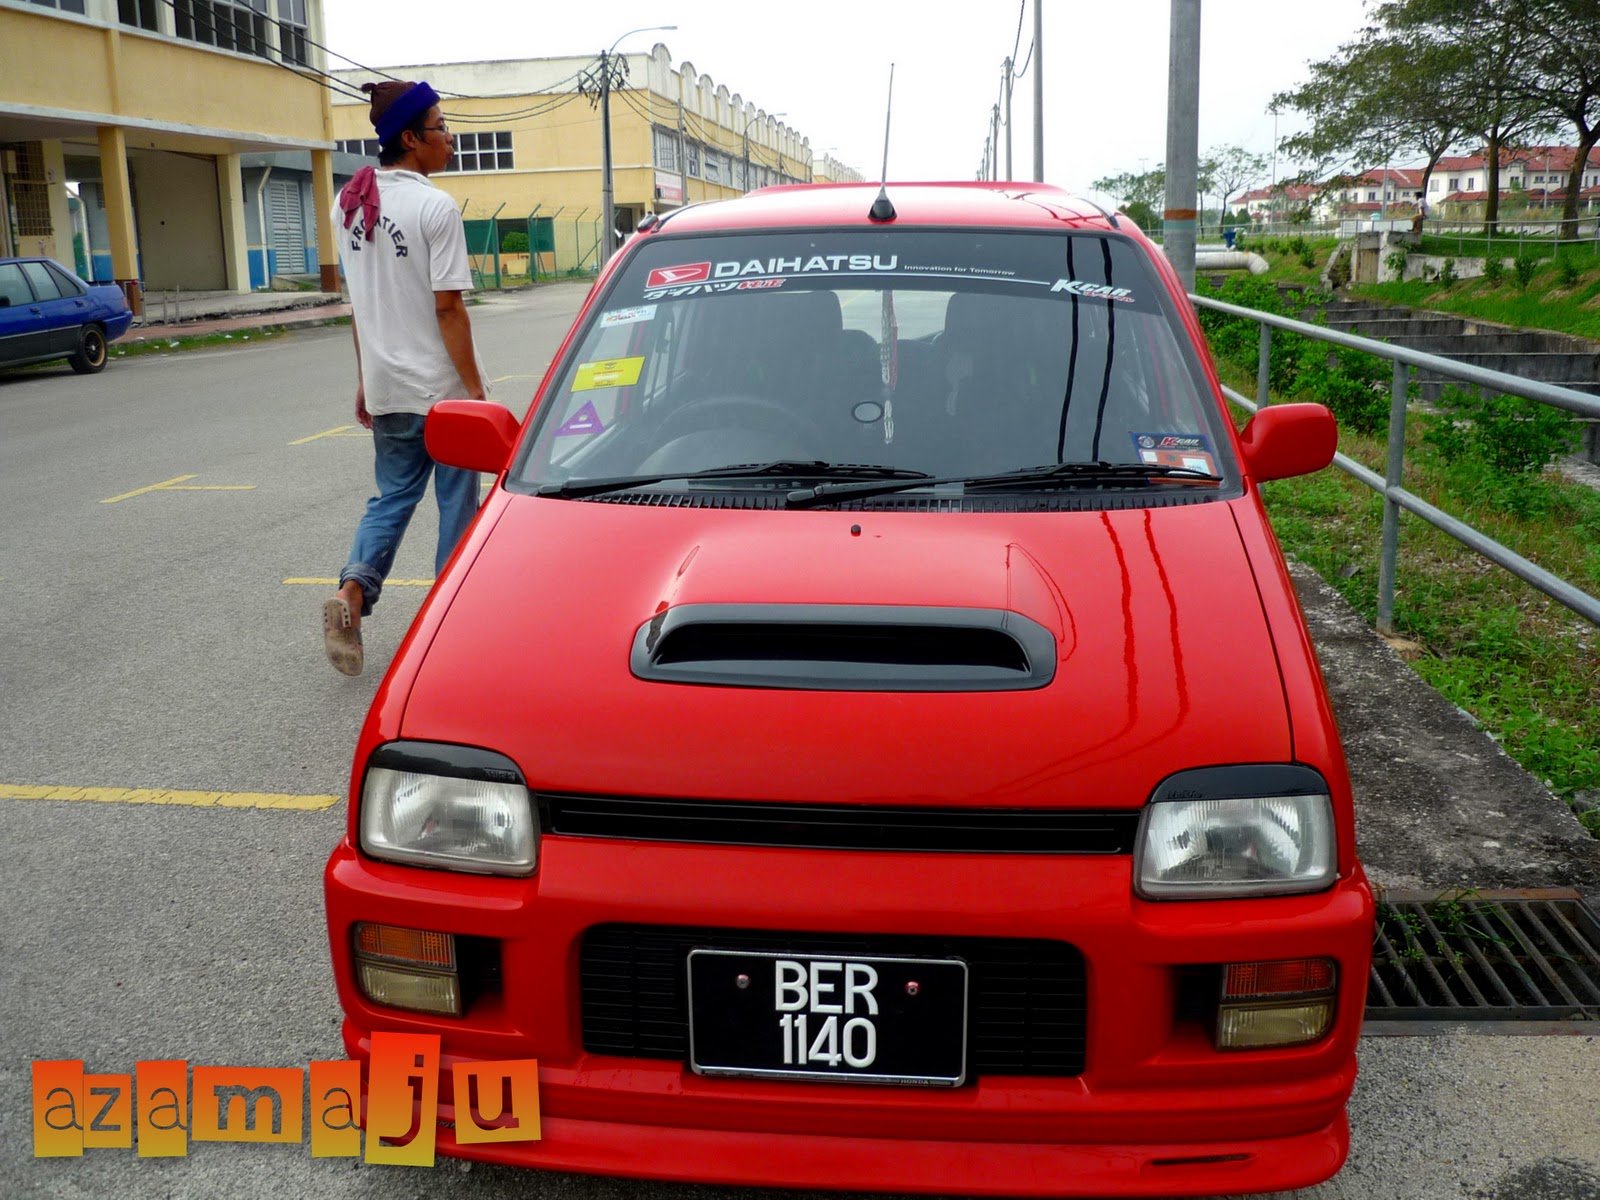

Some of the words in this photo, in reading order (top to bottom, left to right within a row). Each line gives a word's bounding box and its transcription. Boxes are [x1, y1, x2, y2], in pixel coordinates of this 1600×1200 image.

[714, 255, 898, 277] DAIHATSU
[904, 264, 952, 273] Innovation
[970, 267, 1016, 276] Tomorrow
[775, 960, 879, 1015] BER
[779, 1014, 877, 1068] 1140
